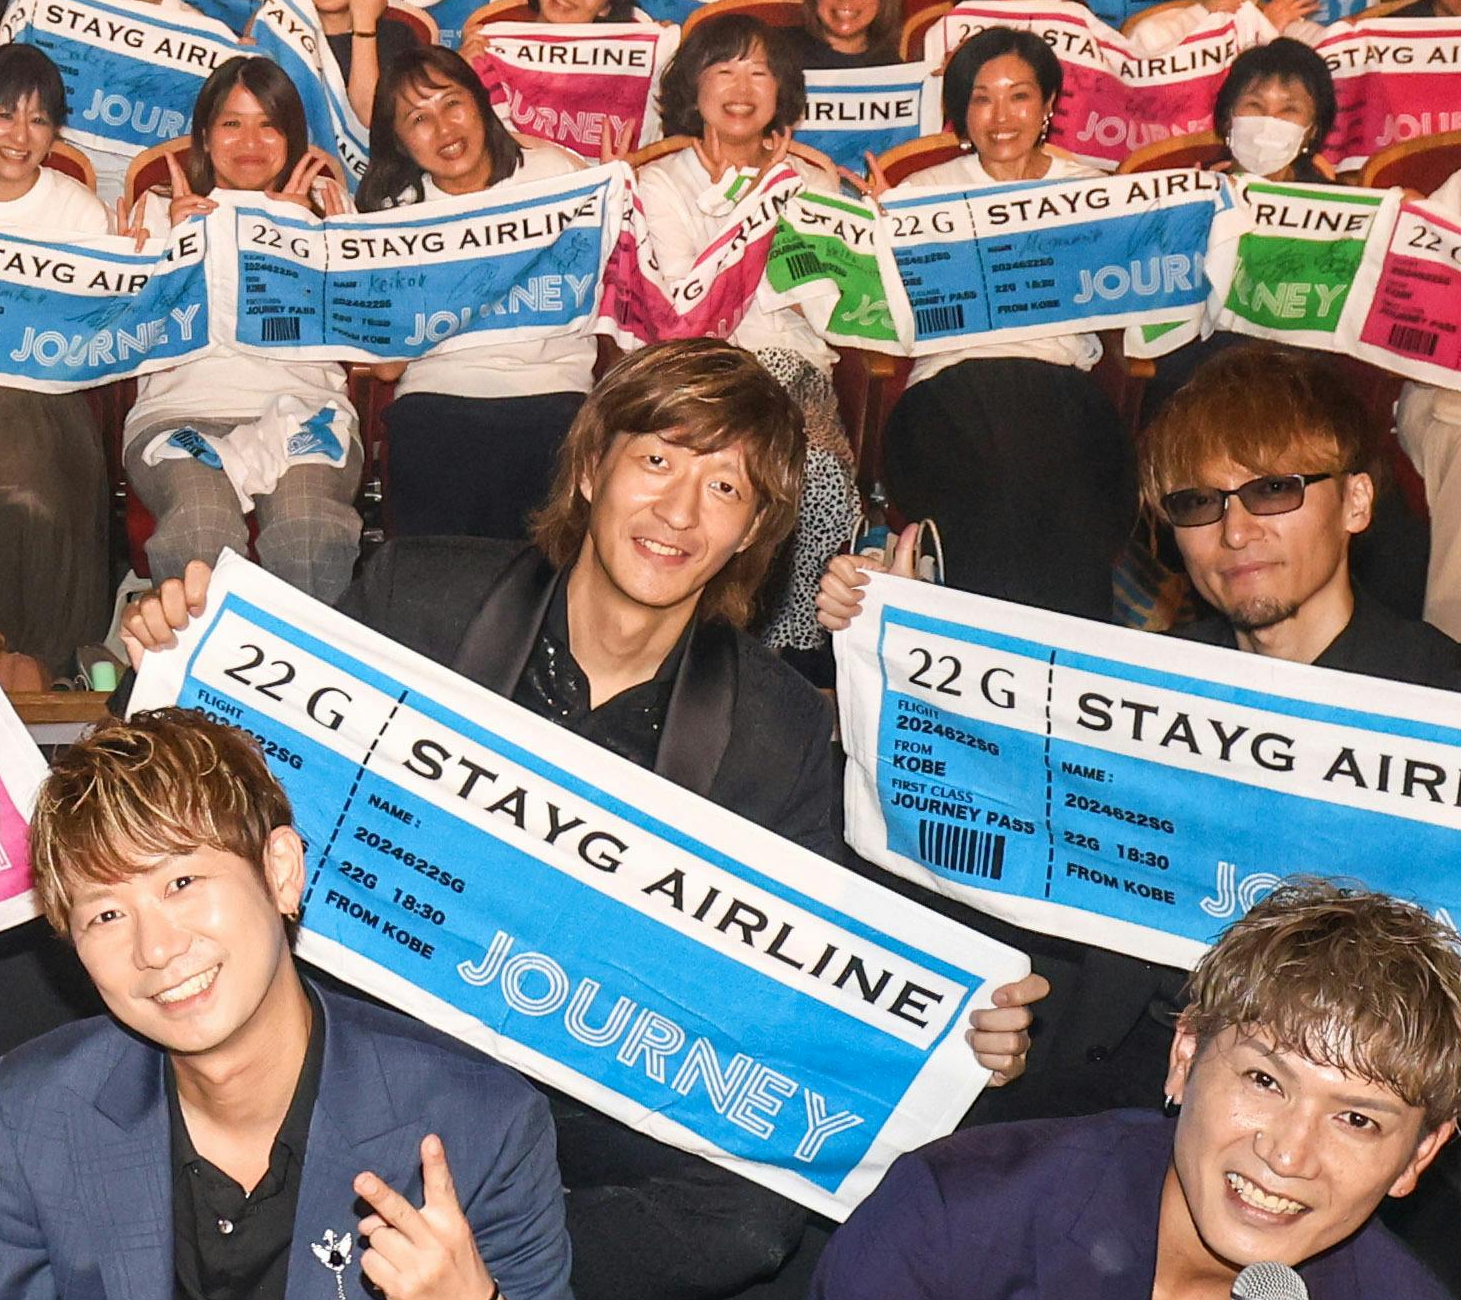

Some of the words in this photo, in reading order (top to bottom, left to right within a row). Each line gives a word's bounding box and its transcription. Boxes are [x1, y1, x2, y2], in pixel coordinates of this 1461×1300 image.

[44, 4, 147, 52] STAYG
[516, 44, 648, 69] AIRLINE
[252, 224, 282, 249] 22
[291, 238, 310, 259] G
[341, 233, 445, 260] STAYG
[459, 195, 598, 250] AIRLINE
[892, 216, 923, 236] 22
[933, 211, 954, 233] G
[988, 188, 1110, 226] STAYG
[10, 303, 201, 368] JOURNEY
[198, 689, 244, 719] FLIGHT
[897, 700, 940, 720] FLIGHT
[908, 647, 962, 696] 22
[980, 667, 1016, 709] G
[1077, 692, 1298, 773] STAYG
[894, 739, 933, 755] FROM
[896, 715, 1000, 757] 2024622SG
[893, 754, 946, 777] KOBE
[892, 778, 926, 796] FIRST
[930, 785, 973, 803] CLASS
[891, 792, 980, 822] JOURNEY
[986, 811, 1036, 835] PASS
[1065, 793, 1175, 834] 2024622SG
[223, 643, 296, 703] 22
[305, 686, 353, 731] G
[402, 737, 626, 875] STAYG
[642, 867, 946, 1031] AIRLINE
[1063, 831, 1100, 851] 22G
[1116, 844, 1169, 871] 18:30
[353, 826, 466, 894] 2024622SG
[338, 860, 377, 889] 22G
[393, 887, 446, 927] 18:30
[1066, 863, 1118, 889] FROM
[1123, 879, 1175, 905] KOBE
[325, 889, 379, 930] FROM
[382, 921, 435, 960] KOBE
[458, 930, 866, 1163] JOURNEY
